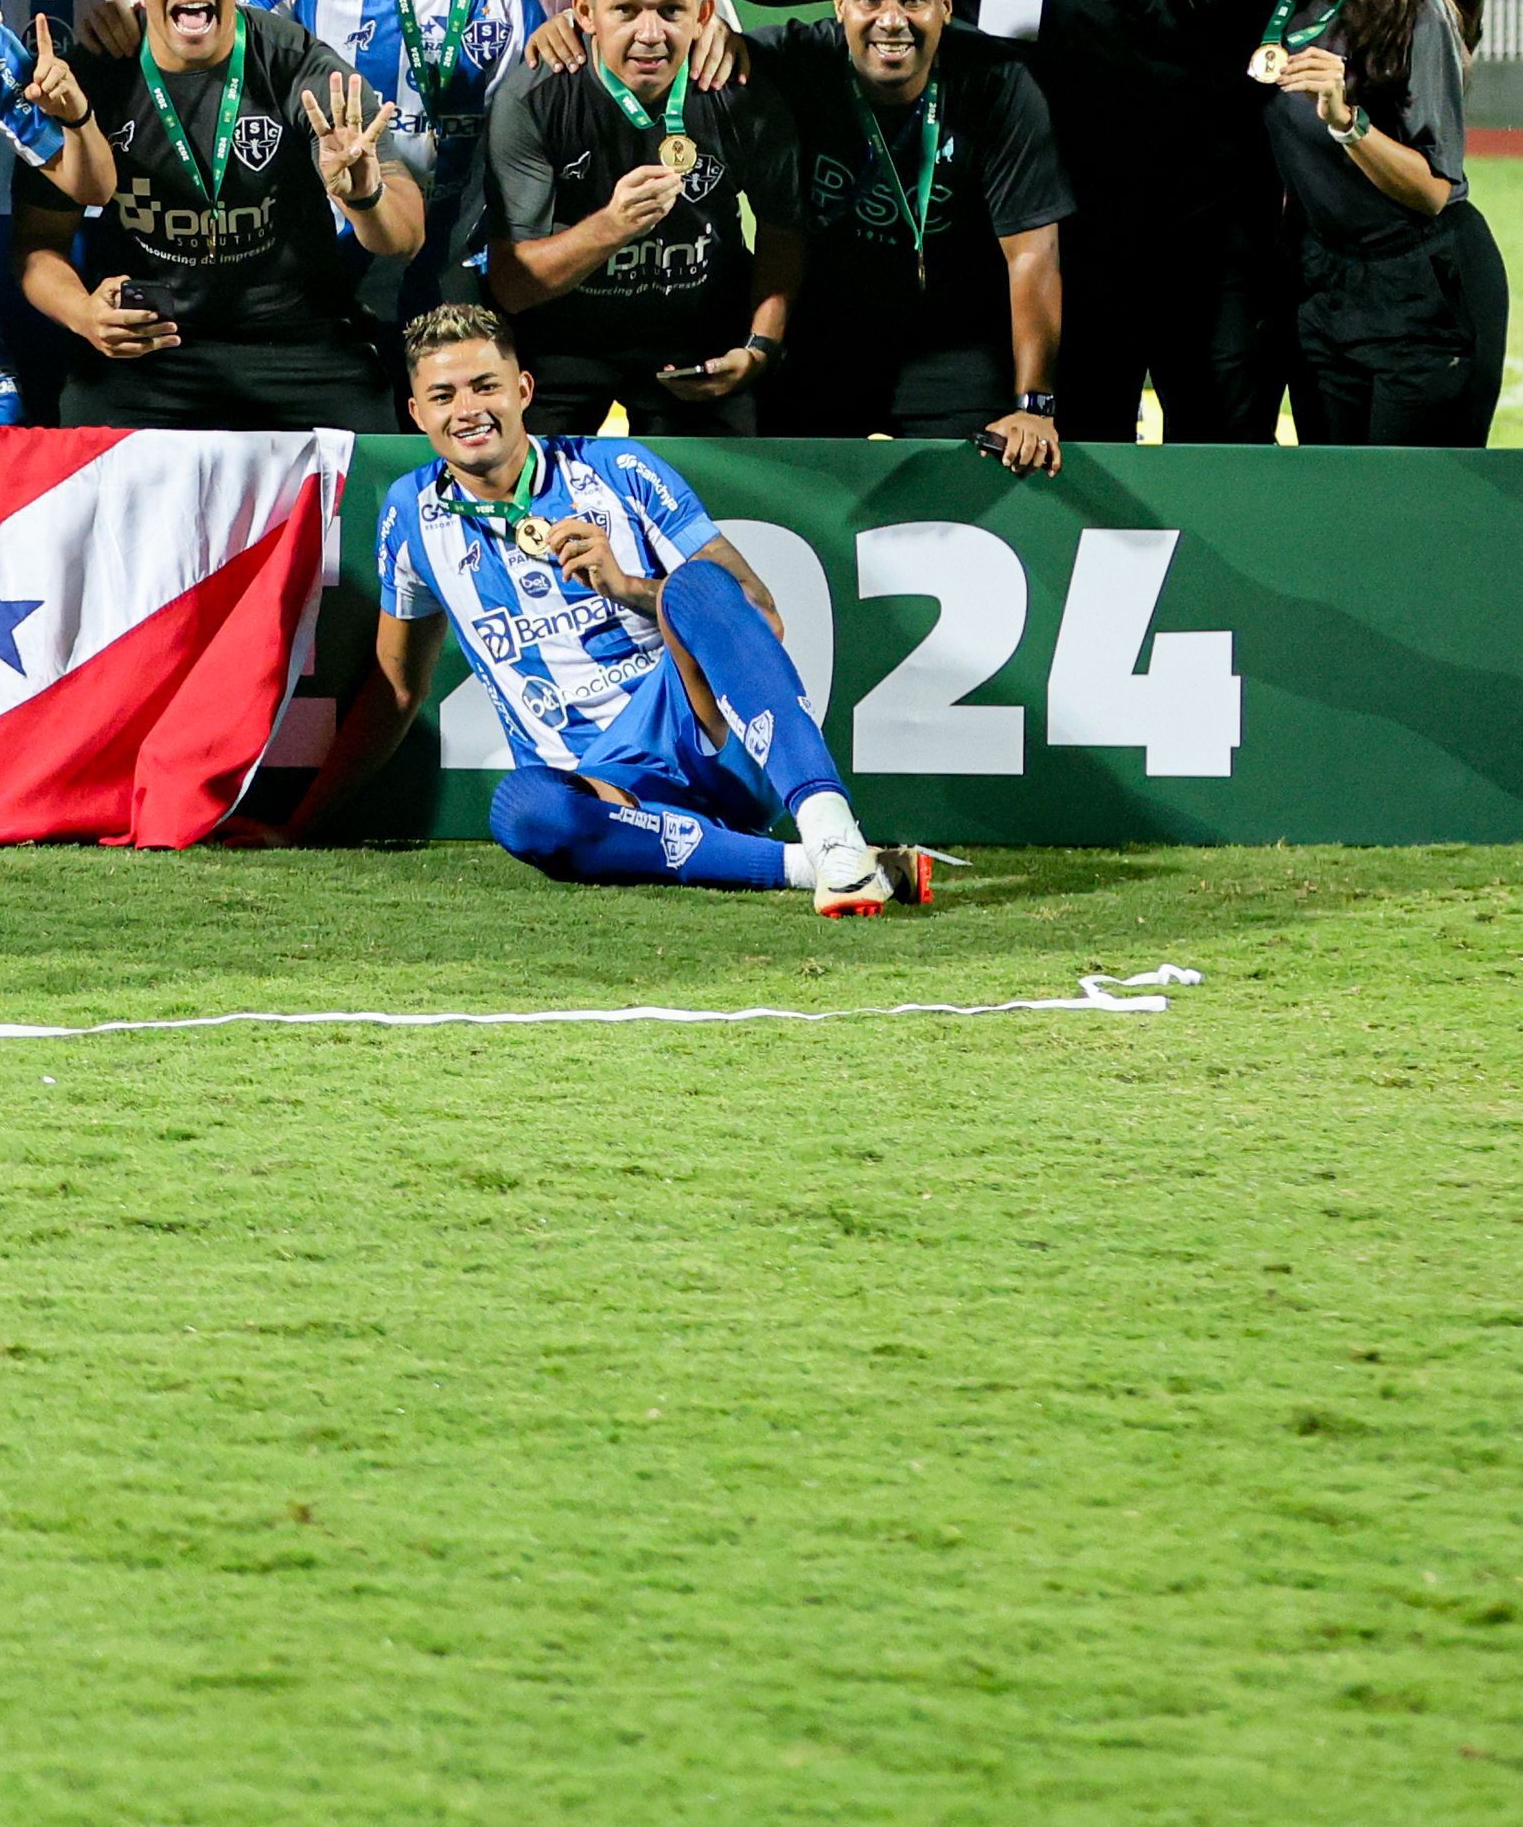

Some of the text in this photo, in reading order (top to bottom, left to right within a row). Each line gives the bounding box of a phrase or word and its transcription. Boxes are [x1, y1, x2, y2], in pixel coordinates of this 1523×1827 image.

[465, 24, 509, 44] PSC
[410, 46, 422, 68] 2024
[442, 45, 455, 68] 2024
[153, 86, 168, 110] 2024
[227, 77, 240, 100] 2024
[926, 101, 938, 125] 2024
[175, 139, 190, 162] 2024
[217, 136, 227, 160] 2024
[164, 196, 277, 241] print
[606, 235, 711, 276] print
[636, 461, 680, 512] Sankhya
[420, 503, 453, 522] GA
[475, 506, 496, 515] 2024
[520, 576, 550, 590] bet
[440, 520, 1244, 778] 024
